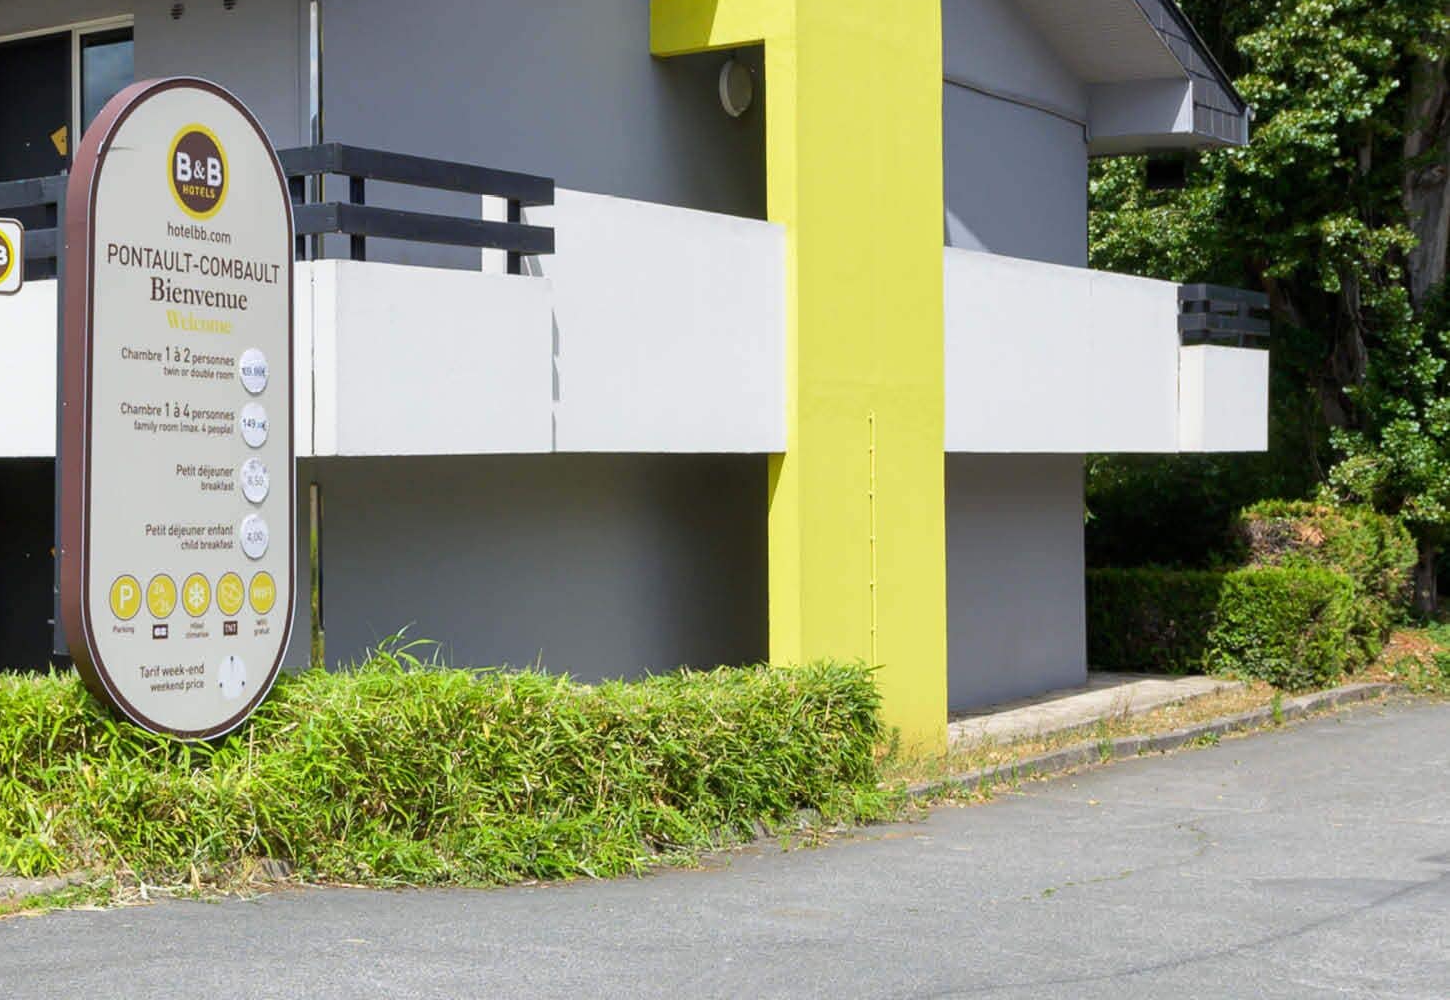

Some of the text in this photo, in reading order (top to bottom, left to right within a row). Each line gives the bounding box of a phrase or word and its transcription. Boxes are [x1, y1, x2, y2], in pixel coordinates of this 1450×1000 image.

[176, 151, 223, 187] B&B
[182, 183, 216, 199] HOTELS
[167, 222, 231, 245] hotelbb.com
[107, 243, 280, 284] PONTAULT-COMBAULT
[150, 276, 248, 311] Bienvenue
[166, 309, 233, 334] Welcome
[121, 346, 235, 367] Chambre 1 à 2 personnes
[163, 366, 180, 377] twin
[190, 367, 214, 379] double
[215, 370, 235, 380] room
[120, 401, 235, 422] Chambre 1 à 4 personnes
[134, 420, 158, 433] family
[159, 422, 179, 432] room
[176, 463, 196, 477] Petit
[200, 479, 235, 491] breakfast
[145, 523, 166, 537] Petit
[207, 523, 233, 537] enfant
[180, 539, 234, 550] child breakfast
[140, 663, 205, 679] Tarif week-end
